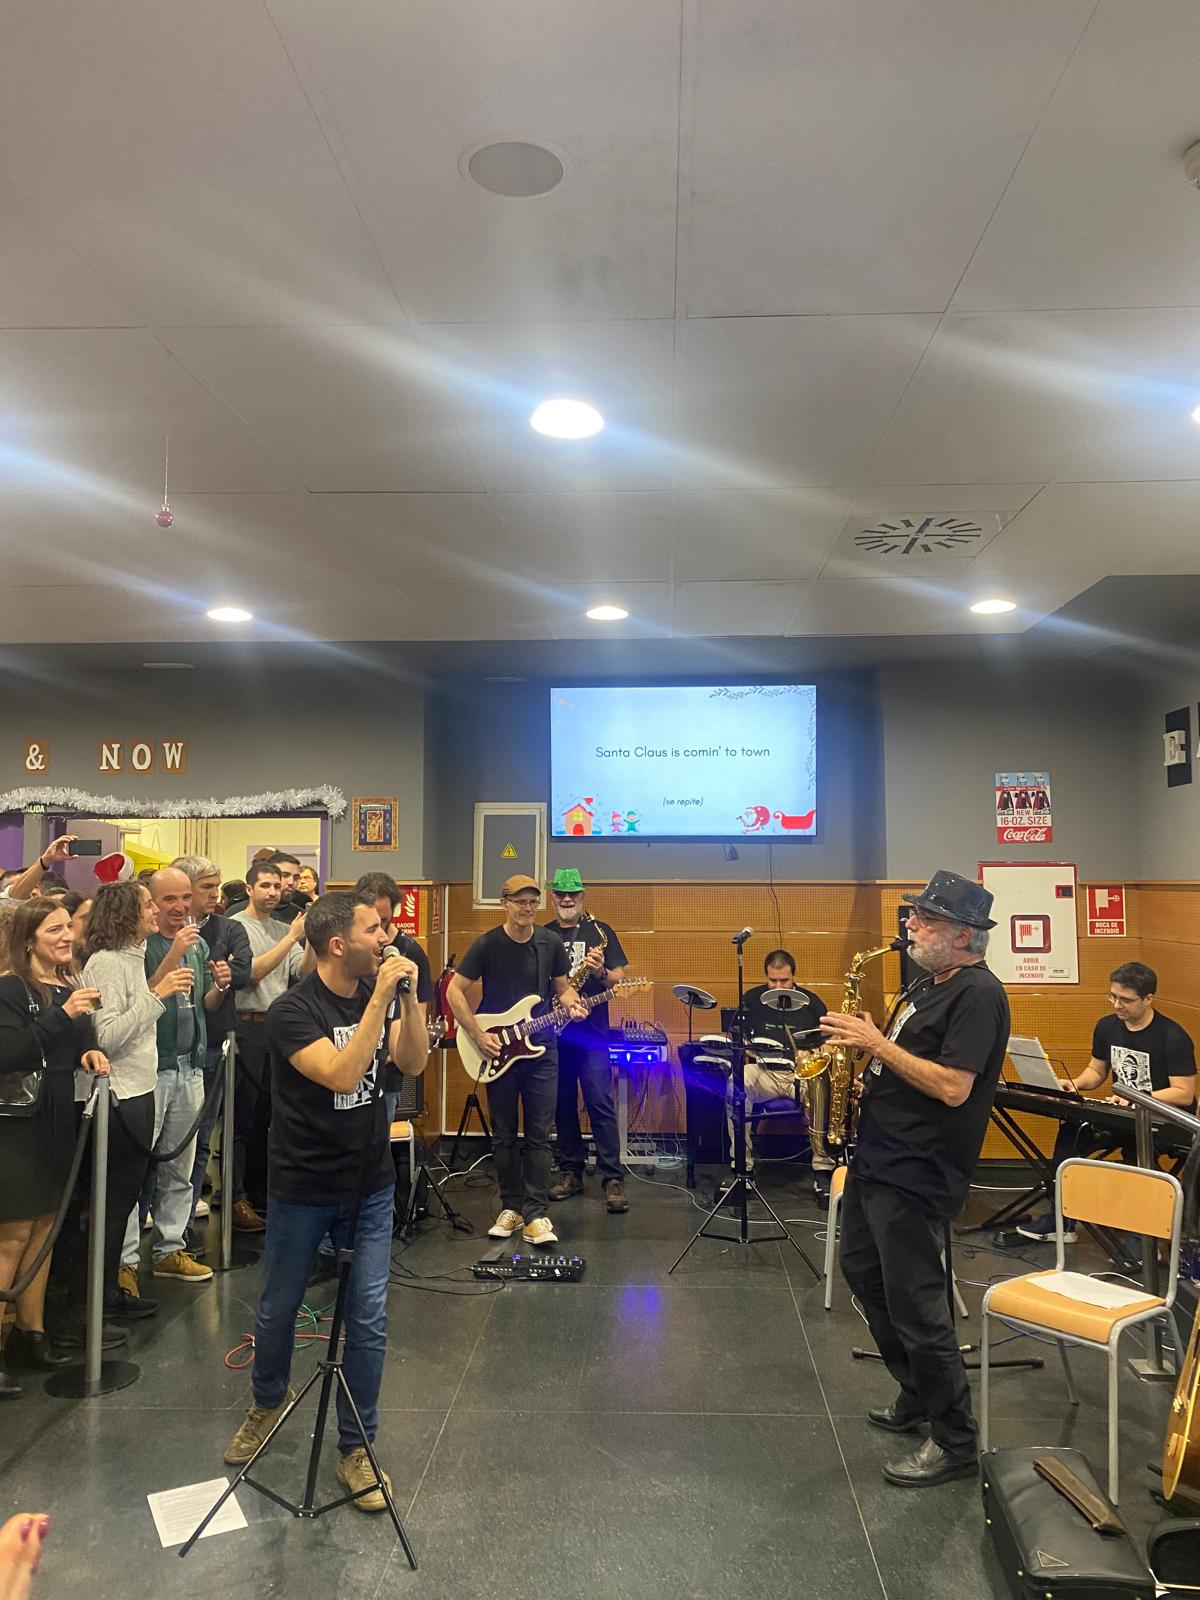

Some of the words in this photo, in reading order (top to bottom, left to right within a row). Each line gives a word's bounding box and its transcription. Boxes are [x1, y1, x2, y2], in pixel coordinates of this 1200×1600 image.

[25, 743, 46, 770] &
[99, 742, 185, 770] NOW
[595, 746, 630, 758] Santa
[634, 746, 668, 758] Claus
[671, 746, 680, 757] is
[683, 745, 722, 757] comin'
[725, 746, 737, 757] to
[741, 746, 770, 757] town
[662, 796, 675, 808] (se
[676, 796, 704, 808] repite)
[1027, 816, 1048, 825] SIZE
